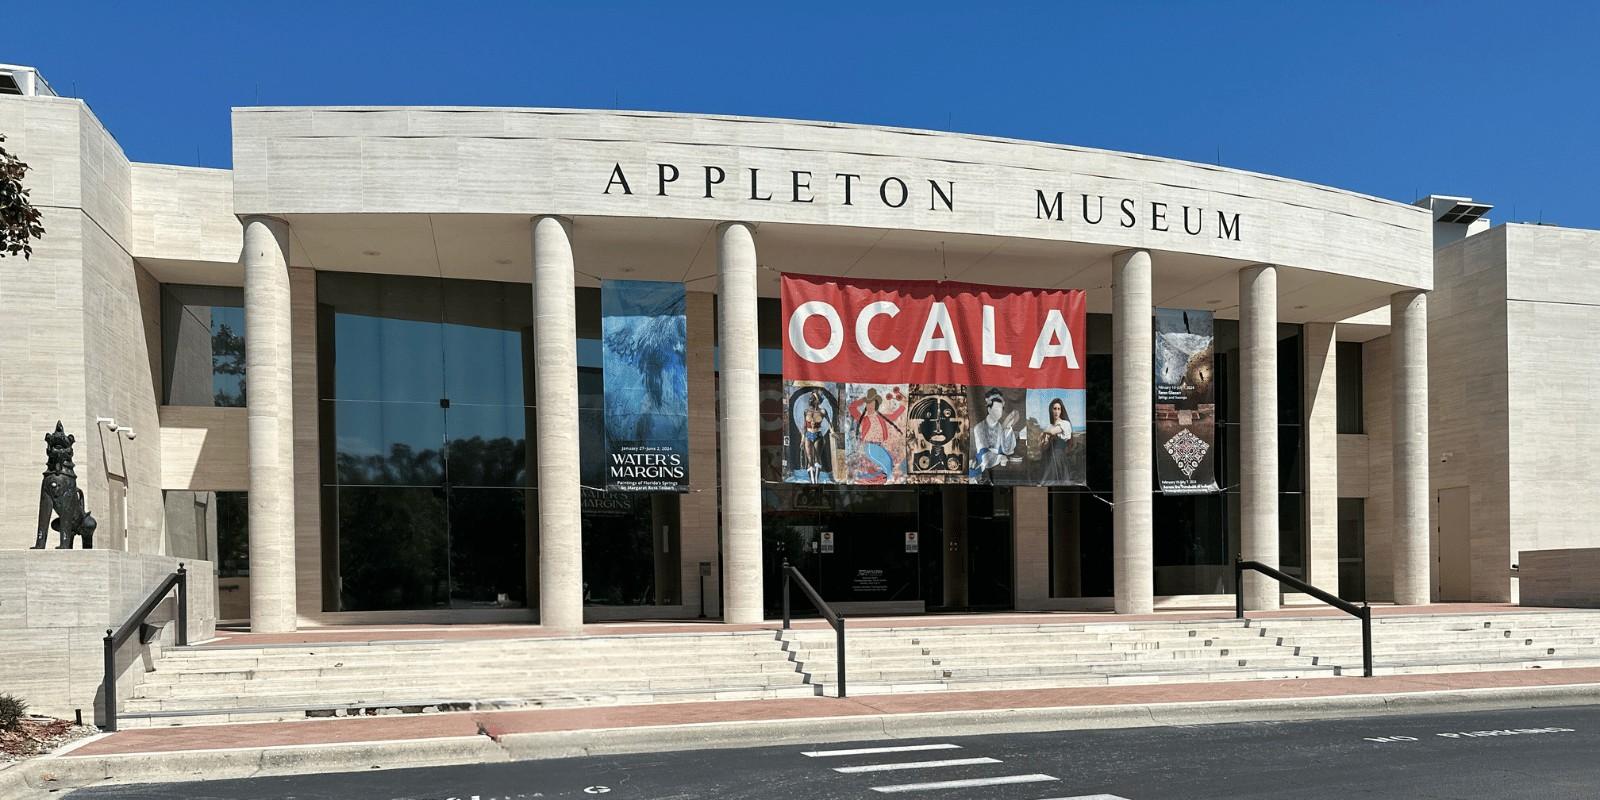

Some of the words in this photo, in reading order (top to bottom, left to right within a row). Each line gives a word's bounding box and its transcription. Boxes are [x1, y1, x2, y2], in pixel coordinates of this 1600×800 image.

[602, 162, 956, 212] APPLETON
[1034, 189, 1241, 241] MUSEUM
[788, 300, 1080, 369] OCALA
[610, 466, 684, 478] MARGINS
[612, 454, 680, 466] WATER'S
